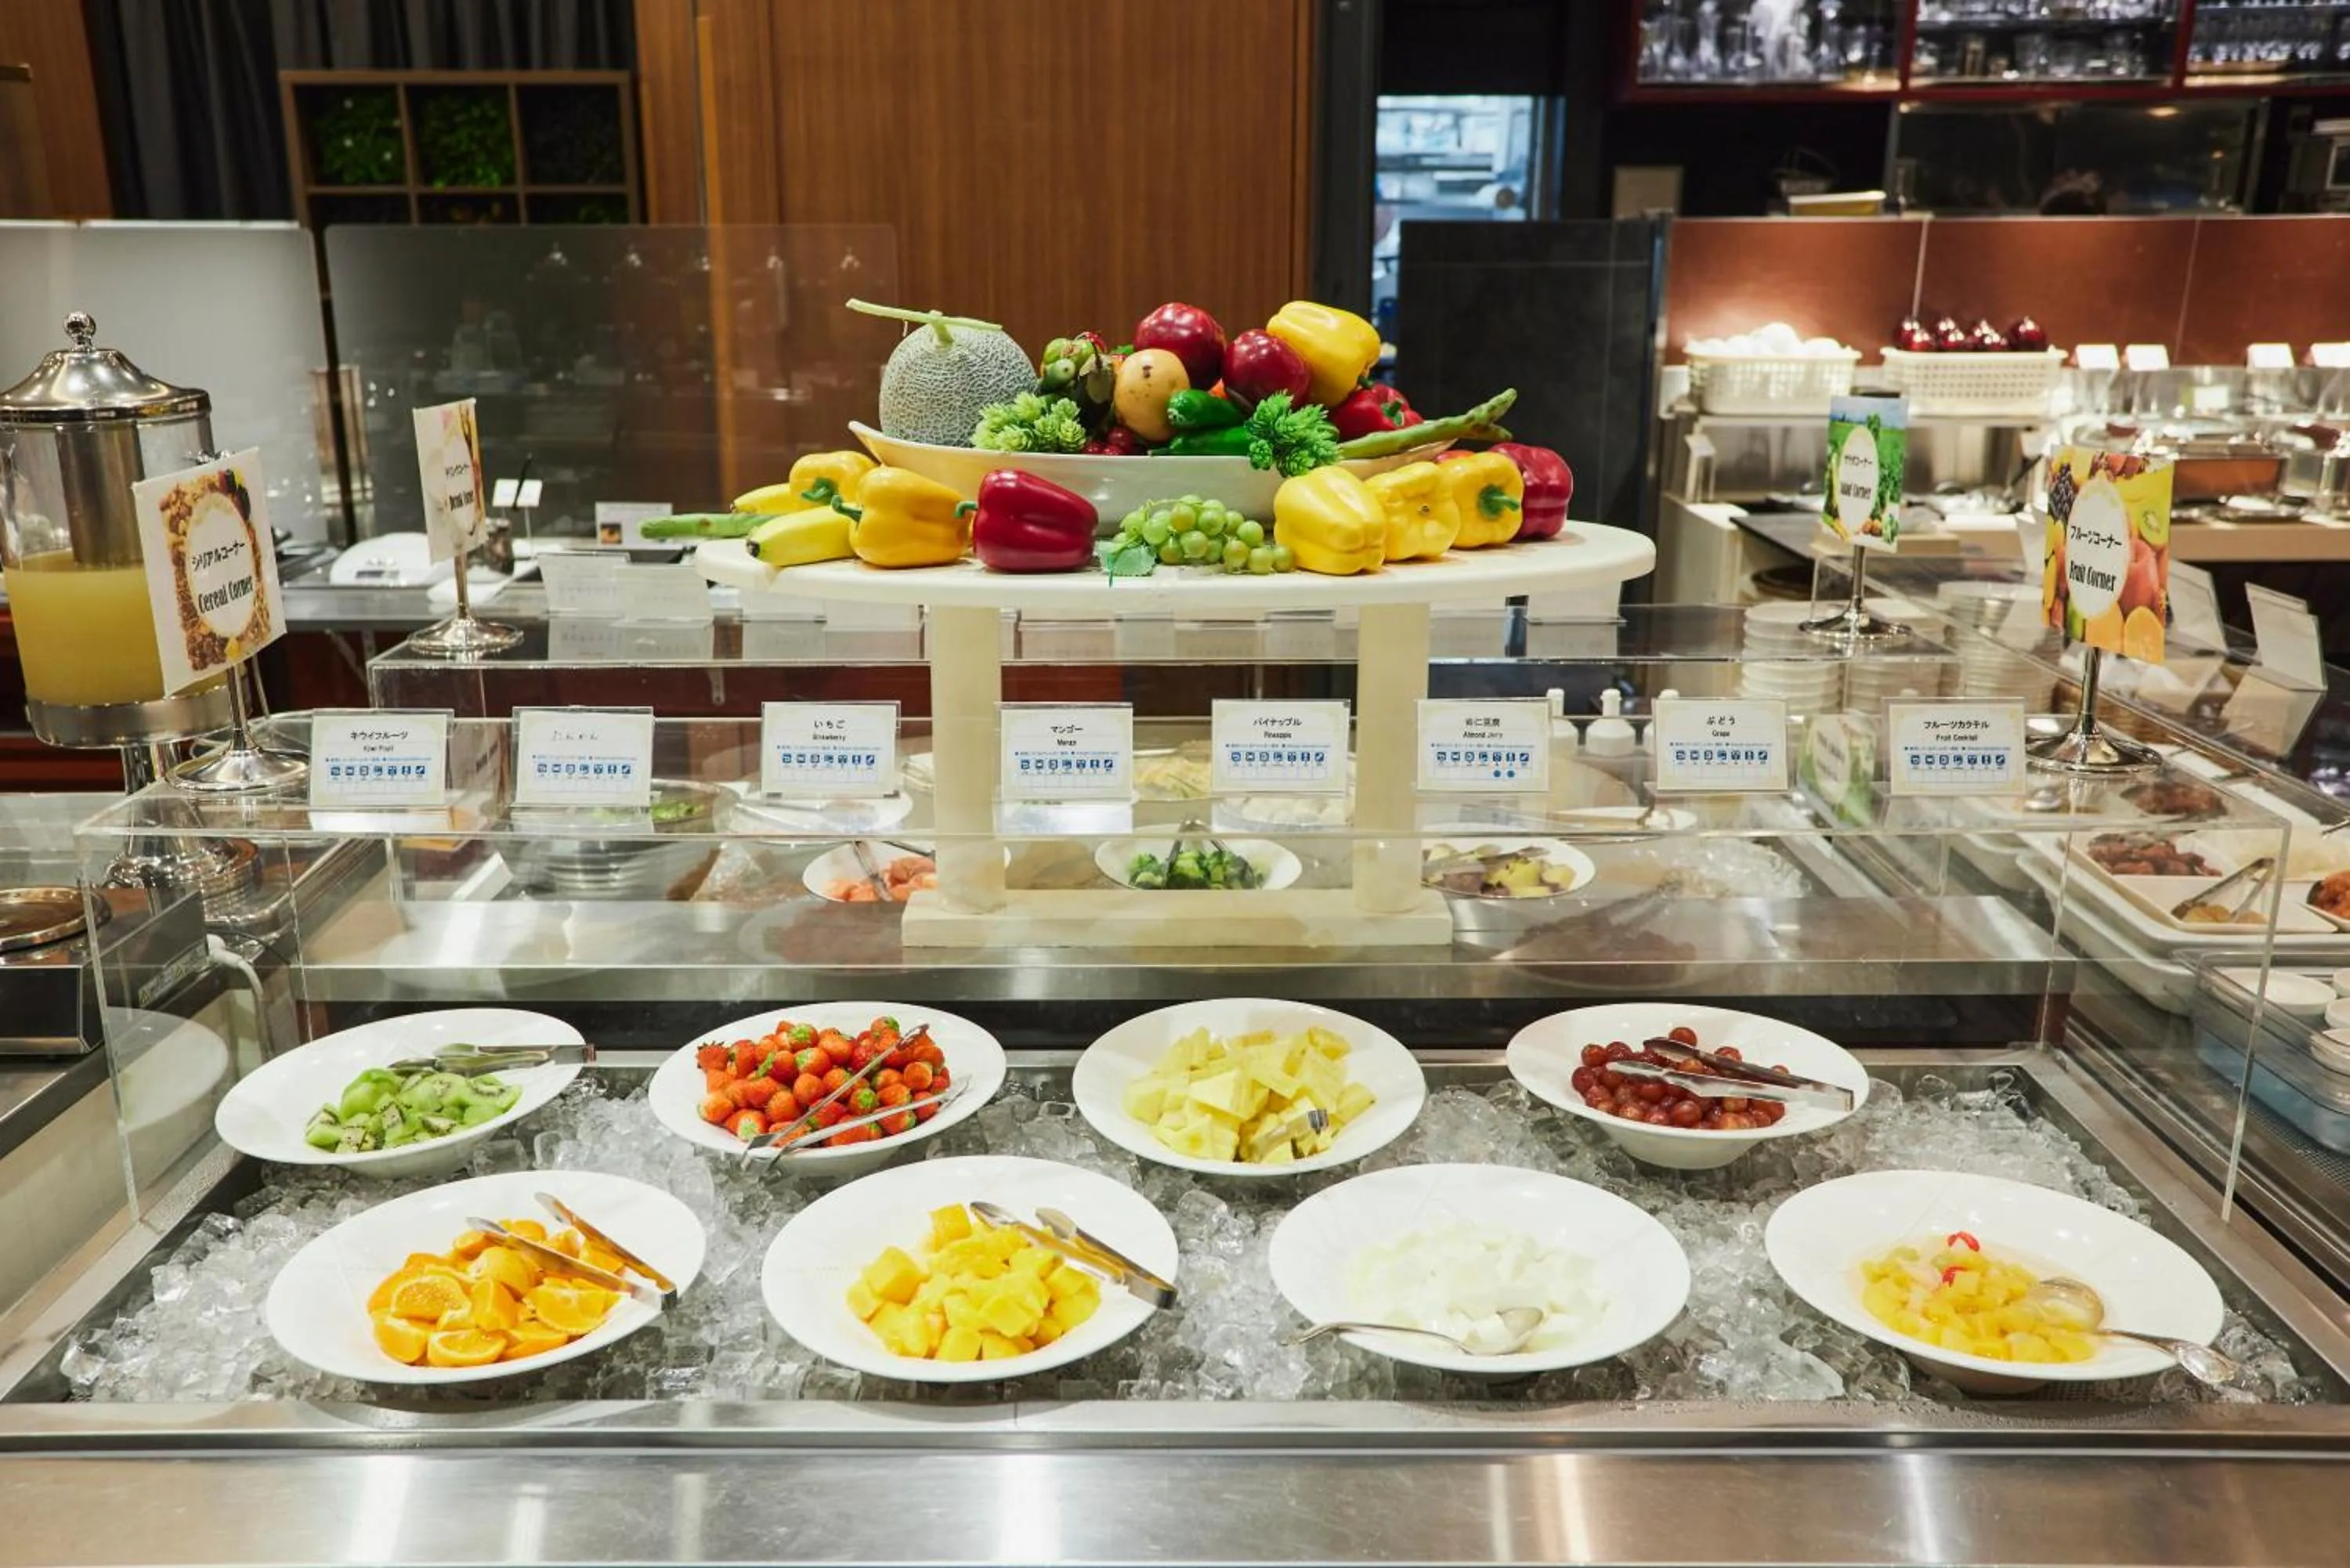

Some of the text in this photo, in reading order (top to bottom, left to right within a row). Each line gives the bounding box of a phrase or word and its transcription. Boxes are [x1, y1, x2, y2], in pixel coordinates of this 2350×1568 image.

[2070, 525, 2123, 549] フルーツコーナー
[191, 540, 246, 573] シリアルコーナー
[2069, 559, 2117, 592] Fruit Corner
[197, 574, 254, 615] Cereal Corner
[814, 719, 846, 729] いちご
[1253, 717, 1303, 727] パイナップル
[1706, 716, 1736, 725] ぶどう
[1923, 720, 1990, 730] フルーツカクテル
[1050, 724, 1083, 734] マンゴー
[350, 731, 408, 740] キウイフルーツ
